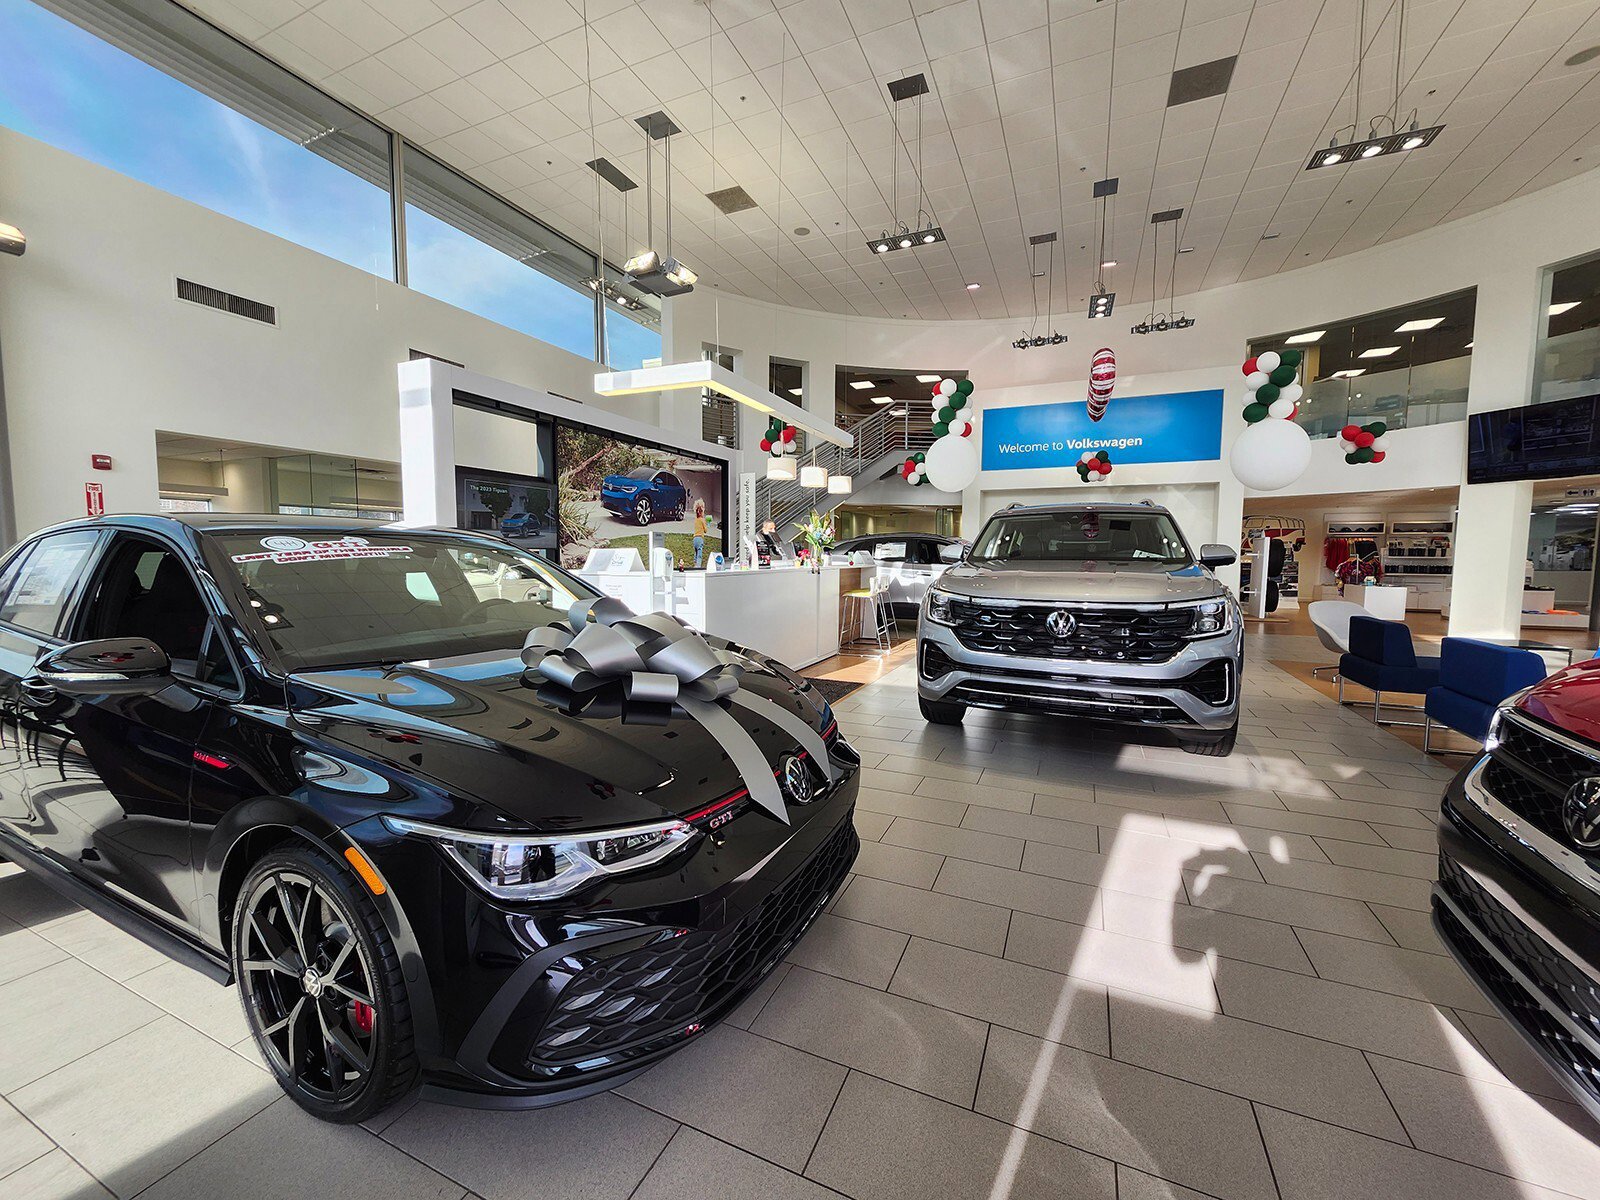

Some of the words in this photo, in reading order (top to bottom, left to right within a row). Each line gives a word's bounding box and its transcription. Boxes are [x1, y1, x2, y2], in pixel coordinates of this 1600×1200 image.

[999, 443, 1049, 453] Welcome
[1052, 442, 1064, 451] to
[1066, 437, 1142, 450] Volkswagen
[312, 541, 361, 549] GTI
[709, 810, 734, 829] GTI
